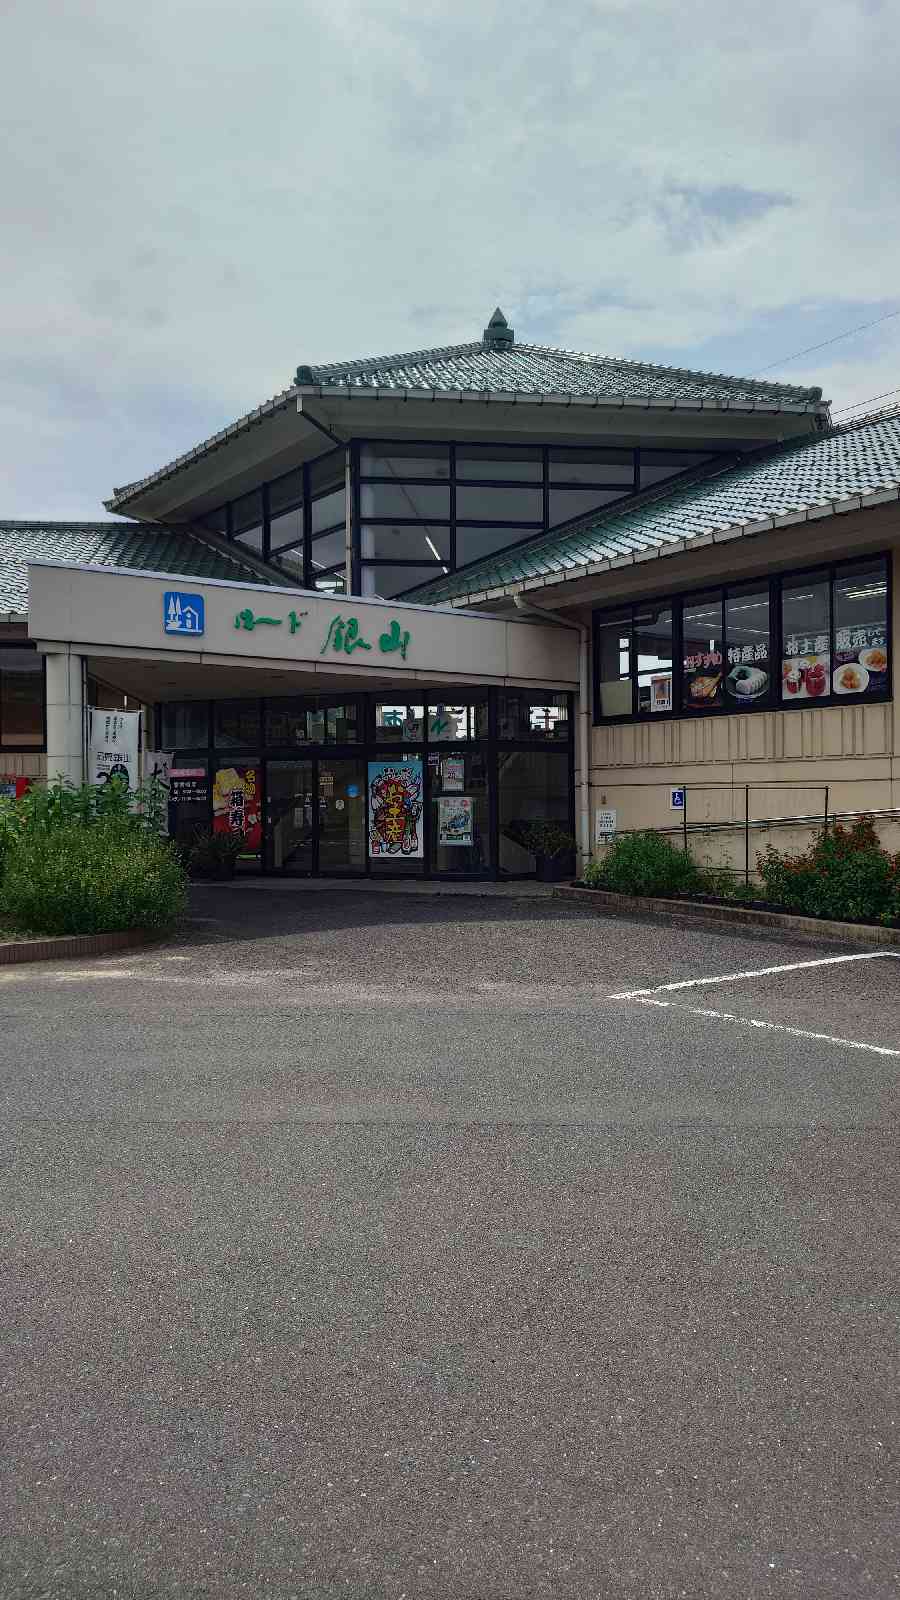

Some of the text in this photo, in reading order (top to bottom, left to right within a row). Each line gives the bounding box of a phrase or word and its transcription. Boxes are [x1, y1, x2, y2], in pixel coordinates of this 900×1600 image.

[233, 608, 411, 661] ロード 銀山
[727, 643, 768, 665] 特産品
